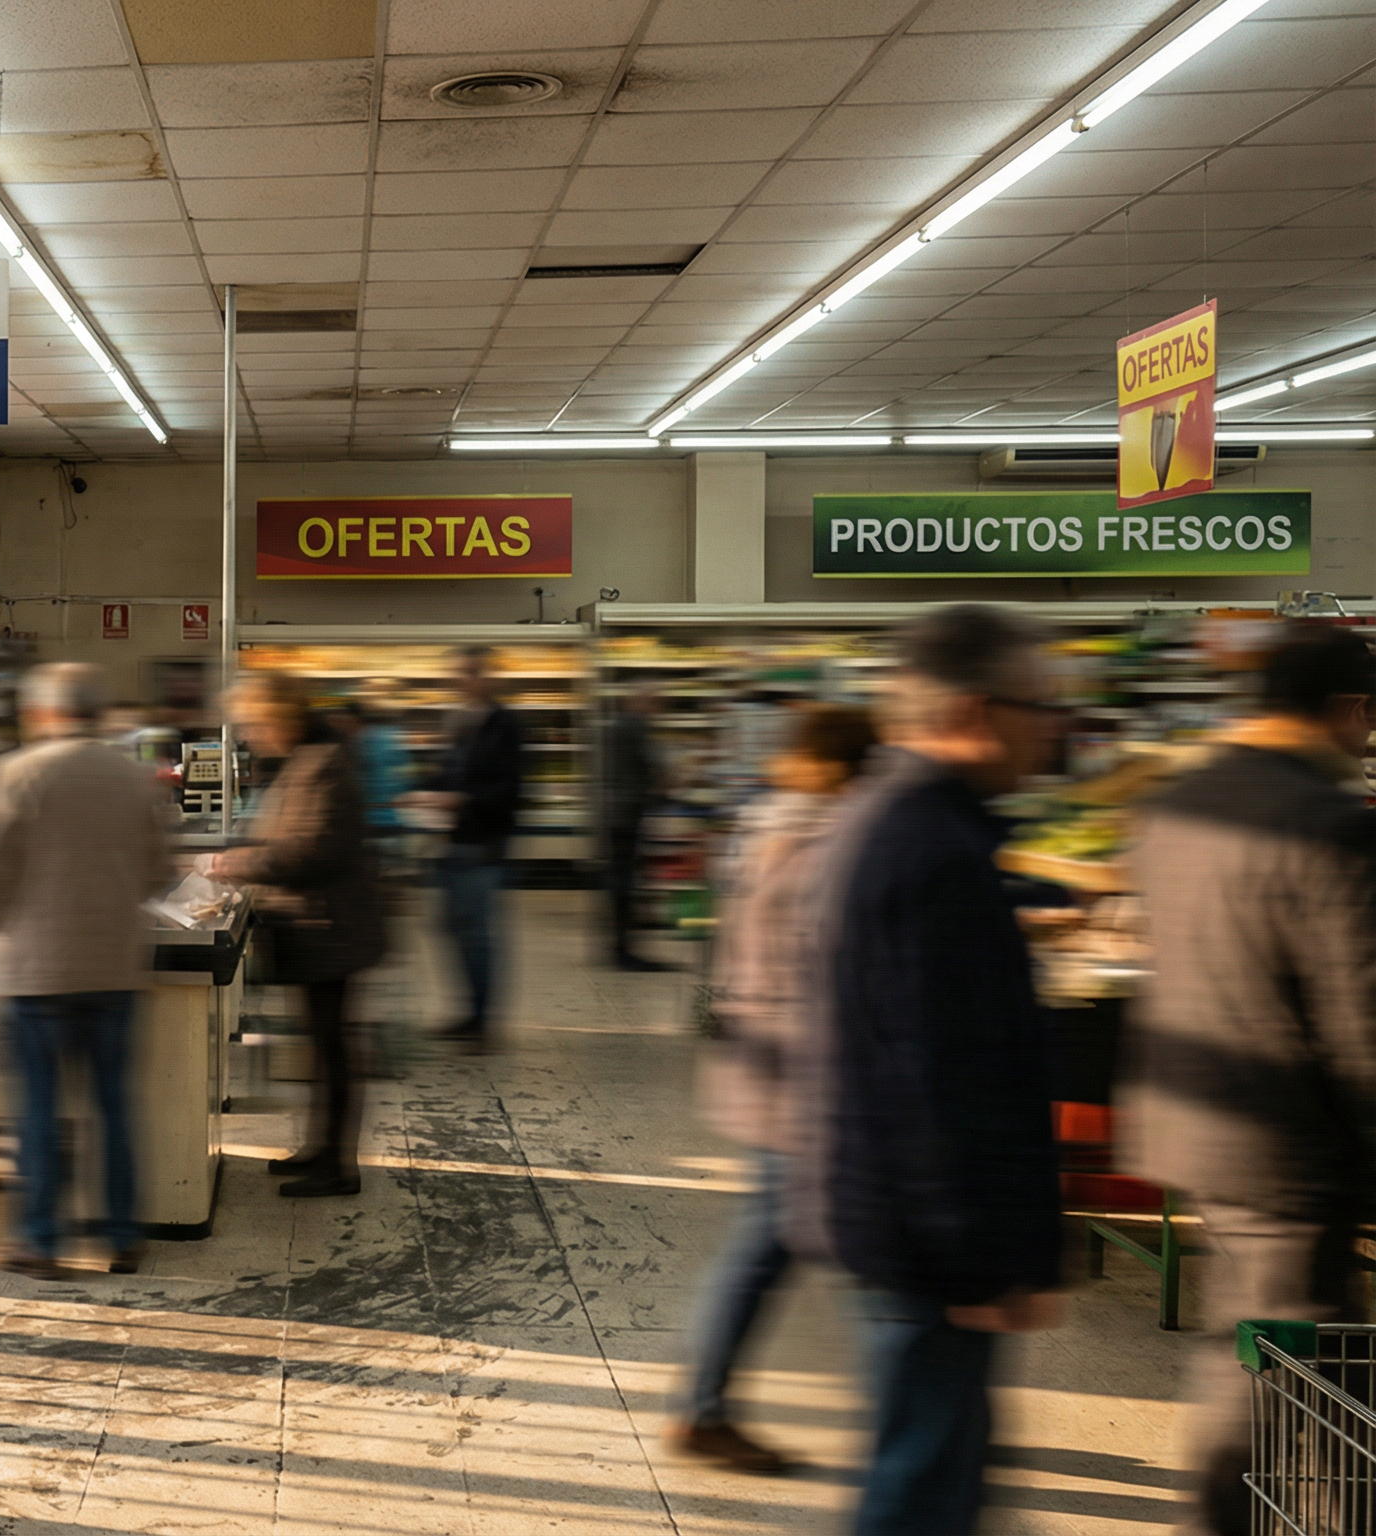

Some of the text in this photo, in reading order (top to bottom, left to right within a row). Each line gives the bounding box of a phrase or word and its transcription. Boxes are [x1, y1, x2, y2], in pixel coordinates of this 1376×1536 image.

[1123, 326, 1208, 392] OFERTAS
[298, 515, 532, 558] OFERTAS
[830, 515, 1293, 553] PRODUCTOS FRESCOS
